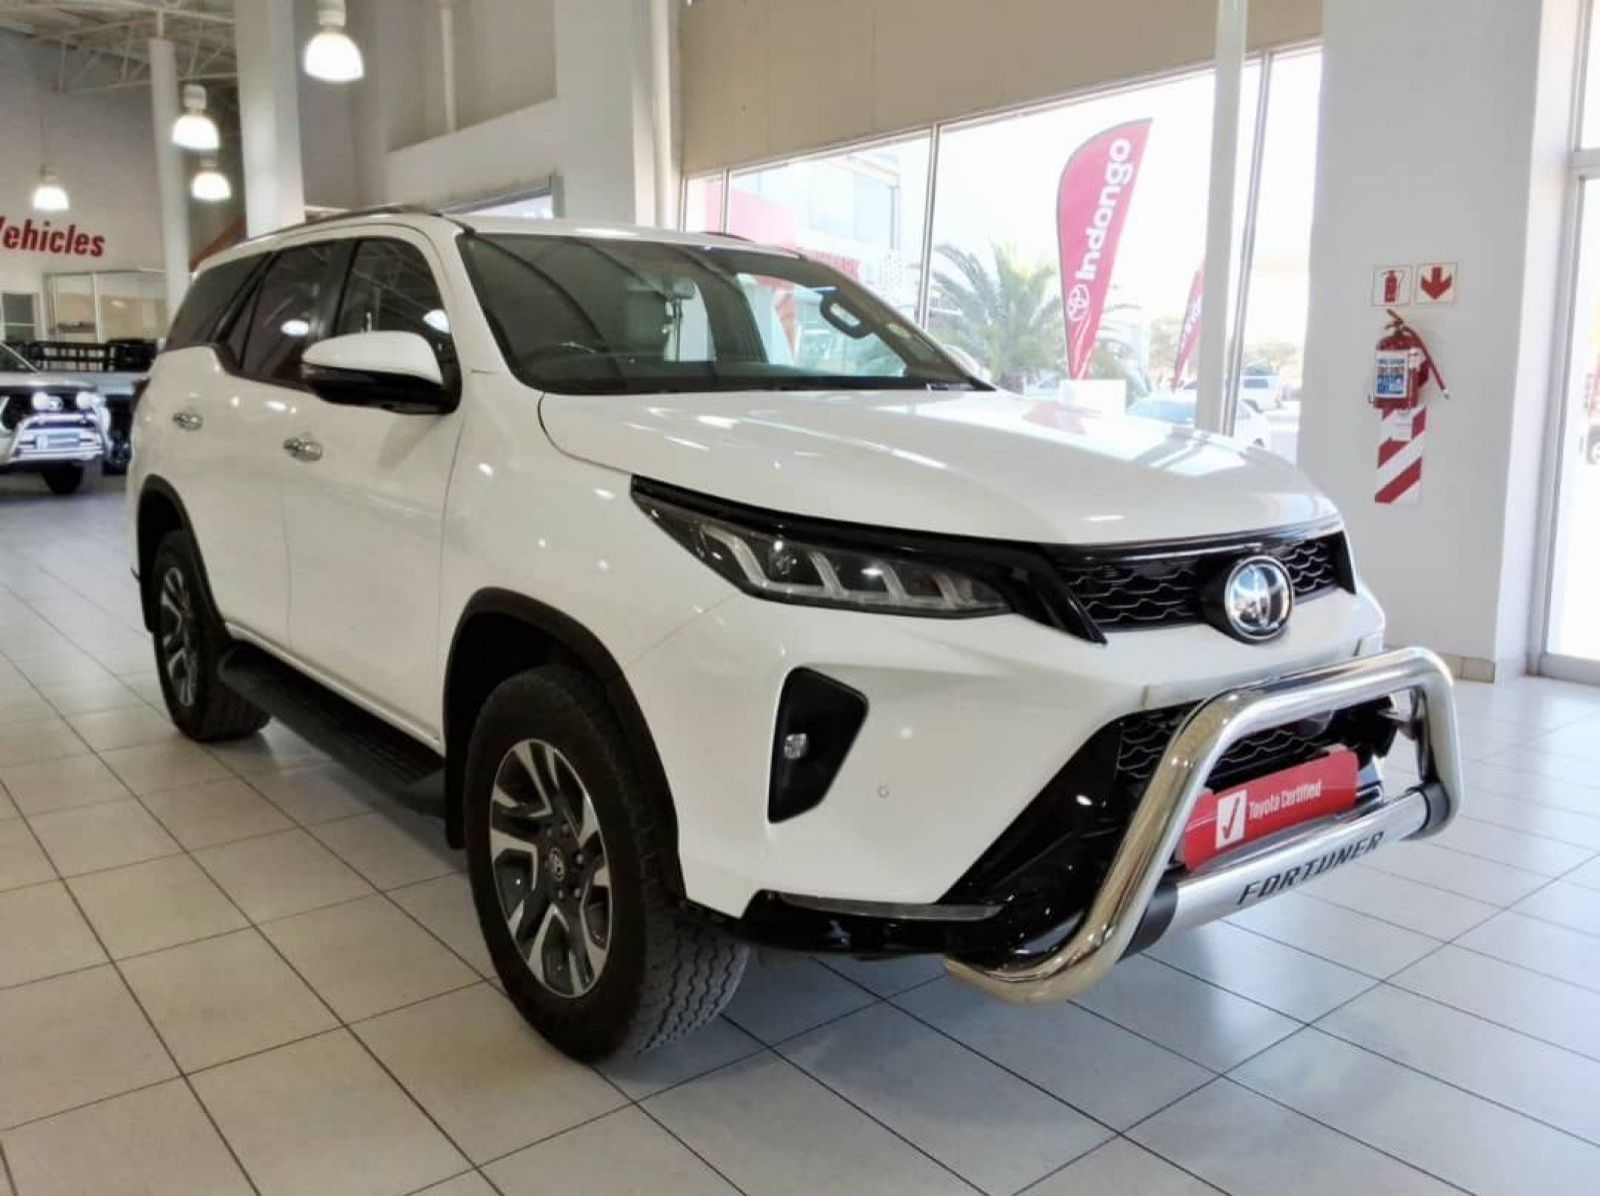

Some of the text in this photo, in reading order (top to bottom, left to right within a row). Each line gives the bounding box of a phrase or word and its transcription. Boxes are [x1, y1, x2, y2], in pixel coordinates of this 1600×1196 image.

[1075, 138, 1133, 280] Indongo
[1249, 780, 1322, 820] Toyota Certified
[1236, 831, 1384, 905] FORTUNER
